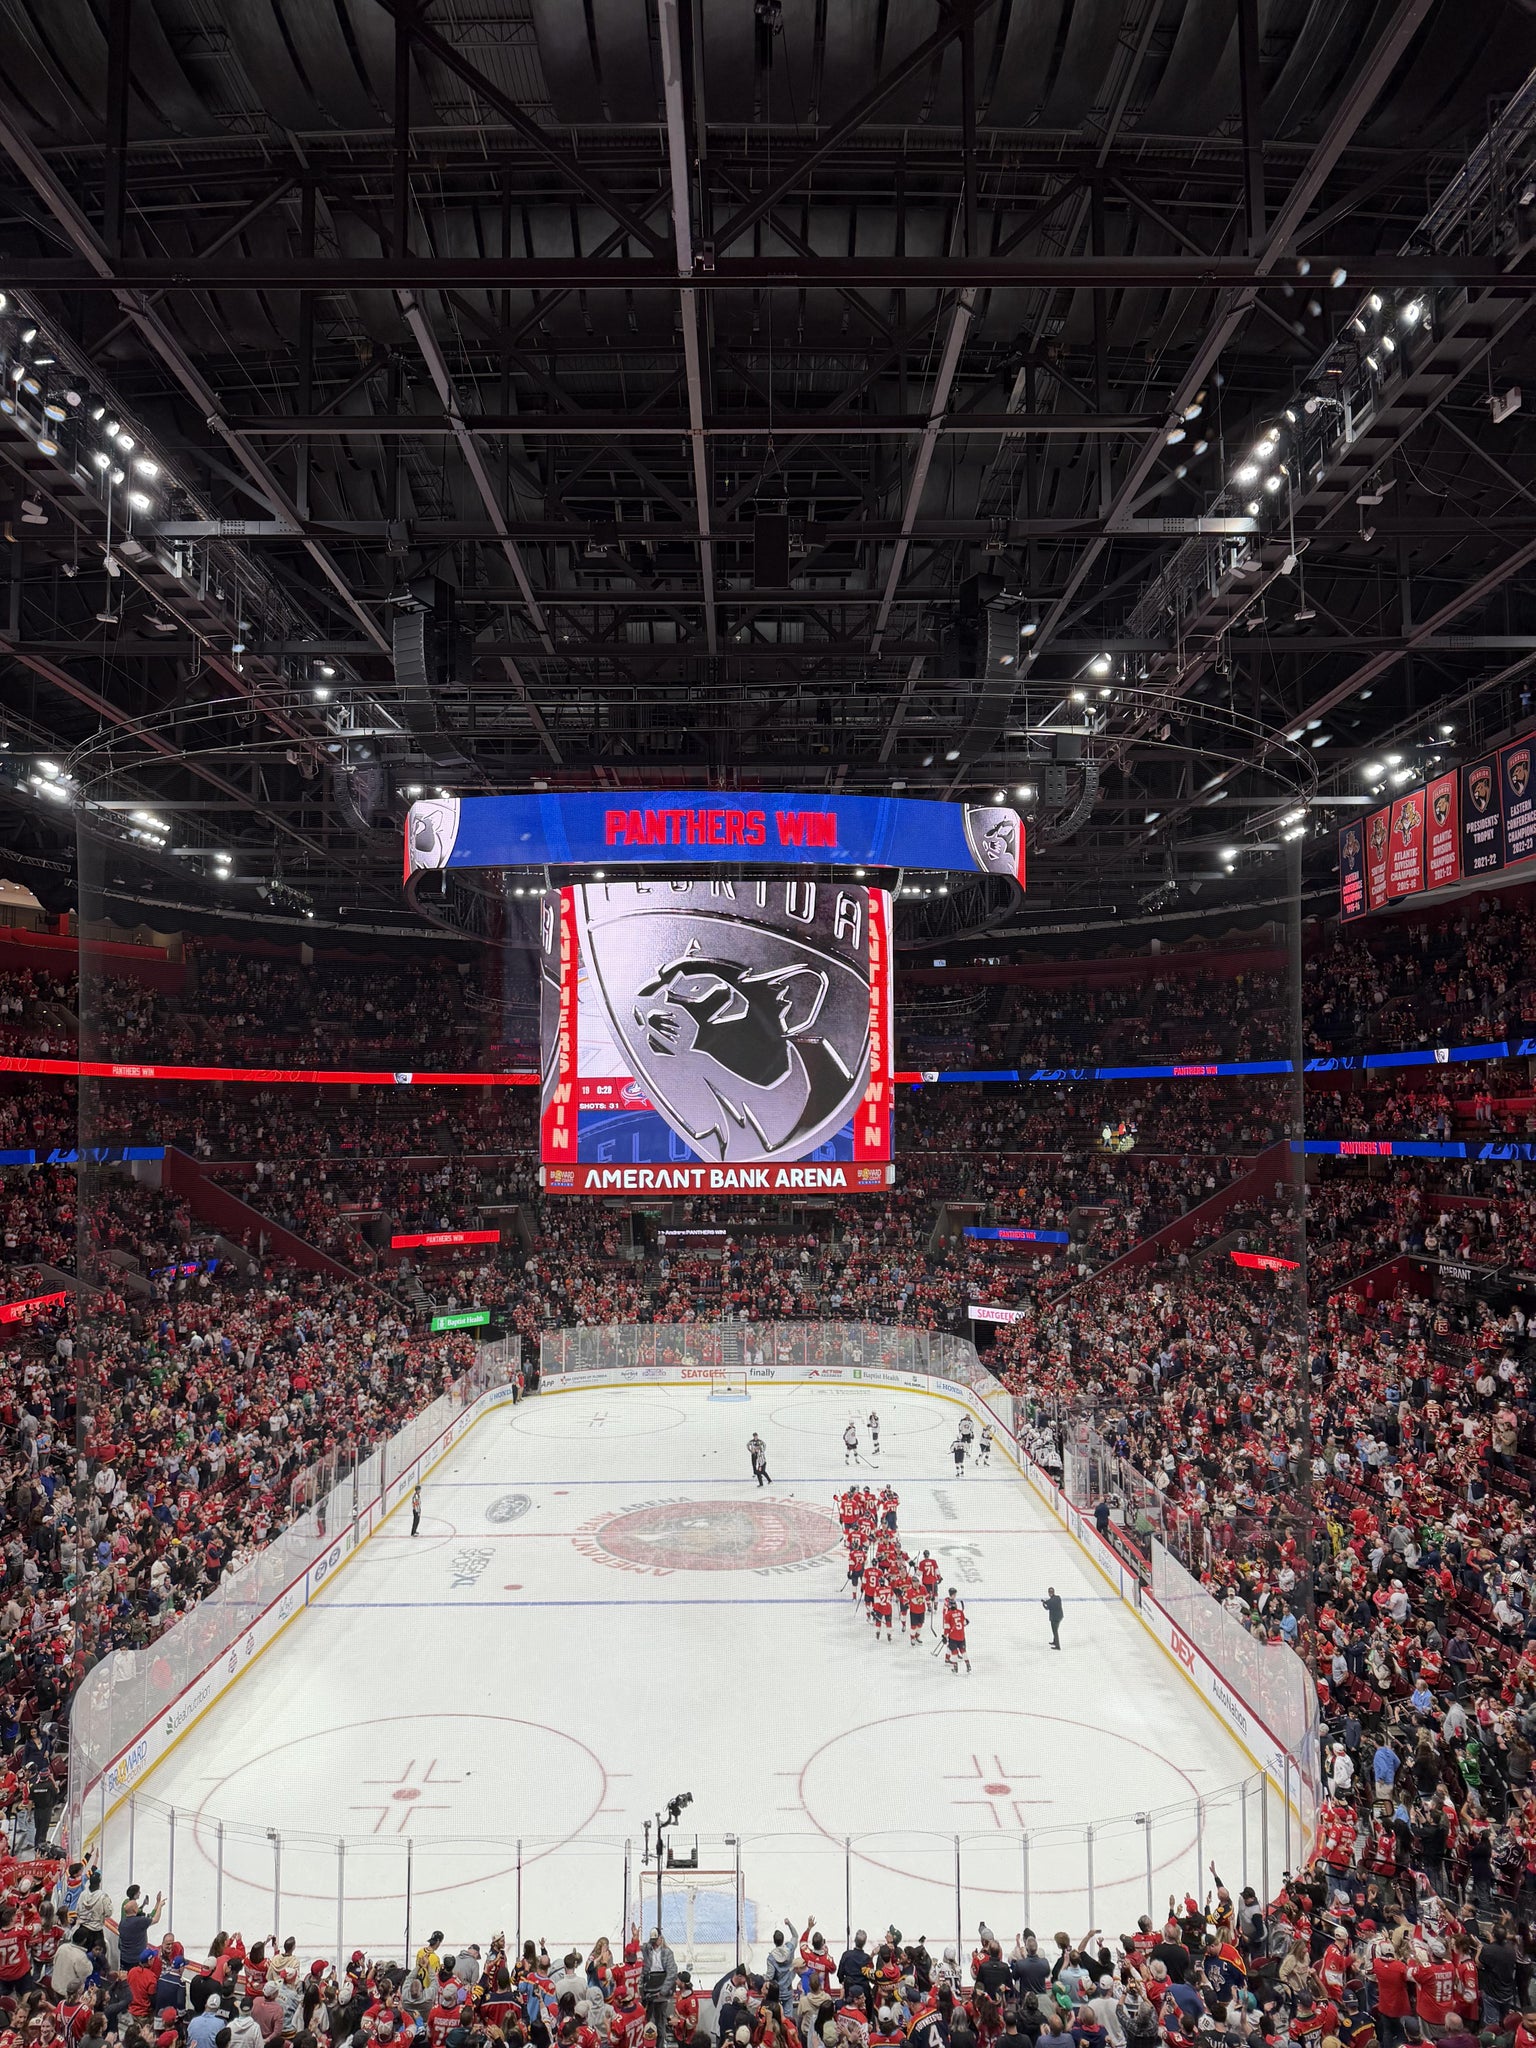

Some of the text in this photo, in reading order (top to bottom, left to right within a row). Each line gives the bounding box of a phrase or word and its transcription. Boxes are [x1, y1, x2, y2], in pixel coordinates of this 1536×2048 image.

[1510, 799, 1532, 817] EASTERN
[1507, 810, 1536, 830] CONFERENCE
[605, 809, 838, 848] PANTHERS WIN
[1508, 825, 1536, 843] CHAMPIONS
[1433, 829, 1452, 846] ATLANTIC
[1473, 829, 1494, 844] TROPHY
[1433, 842, 1452, 857] DIVISION
[1512, 838, 1533, 854] 2022-23
[1394, 847, 1418, 862] ATLANTIC
[1430, 852, 1455, 870] CHAMPIONS
[1474, 853, 1497, 869] 2021-22
[1394, 858, 1417, 871] DIVISION
[1391, 866, 1420, 882] CHAMPIONS
[112, 1066, 154, 1076] PANTHERS WIN
[1173, 1066, 1217, 1076] PANTHERS WIN
[553, 1083, 571, 1148] WIN
[864, 1082, 883, 1146] WIN
[1340, 1141, 1392, 1154] PANTHERS WIN
[584, 1167, 847, 1189] AMERANT BANK ARENA
[426, 1235, 452, 1243] PANTHERS
[998, 1230, 1036, 1240] PANTHERS WIN
[1439, 1265, 1471, 1280] AMERANT
[447, 1315, 484, 1326] Baptist Health
[977, 1309, 1014, 1321] SEATGEEK
[681, 1369, 726, 1378] SEATGEEK
[750, 1368, 775, 1378] finally
[863, 1372, 900, 1381] Baptist Health
[942, 1384, 964, 1397] HONDA
[845, 1506, 853, 1516] 13
[860, 1525, 871, 1536] 20
[924, 1565, 935, 1576] 71
[869, 1576, 876, 1587] 9
[954, 1617, 963, 1630] 5
[1171, 1629, 1194, 1675] DEX
[1213, 1679, 1248, 1733] AutoNation
[1434, 1979, 1452, 2003] 19
[928, 2023, 945, 2048] 4
